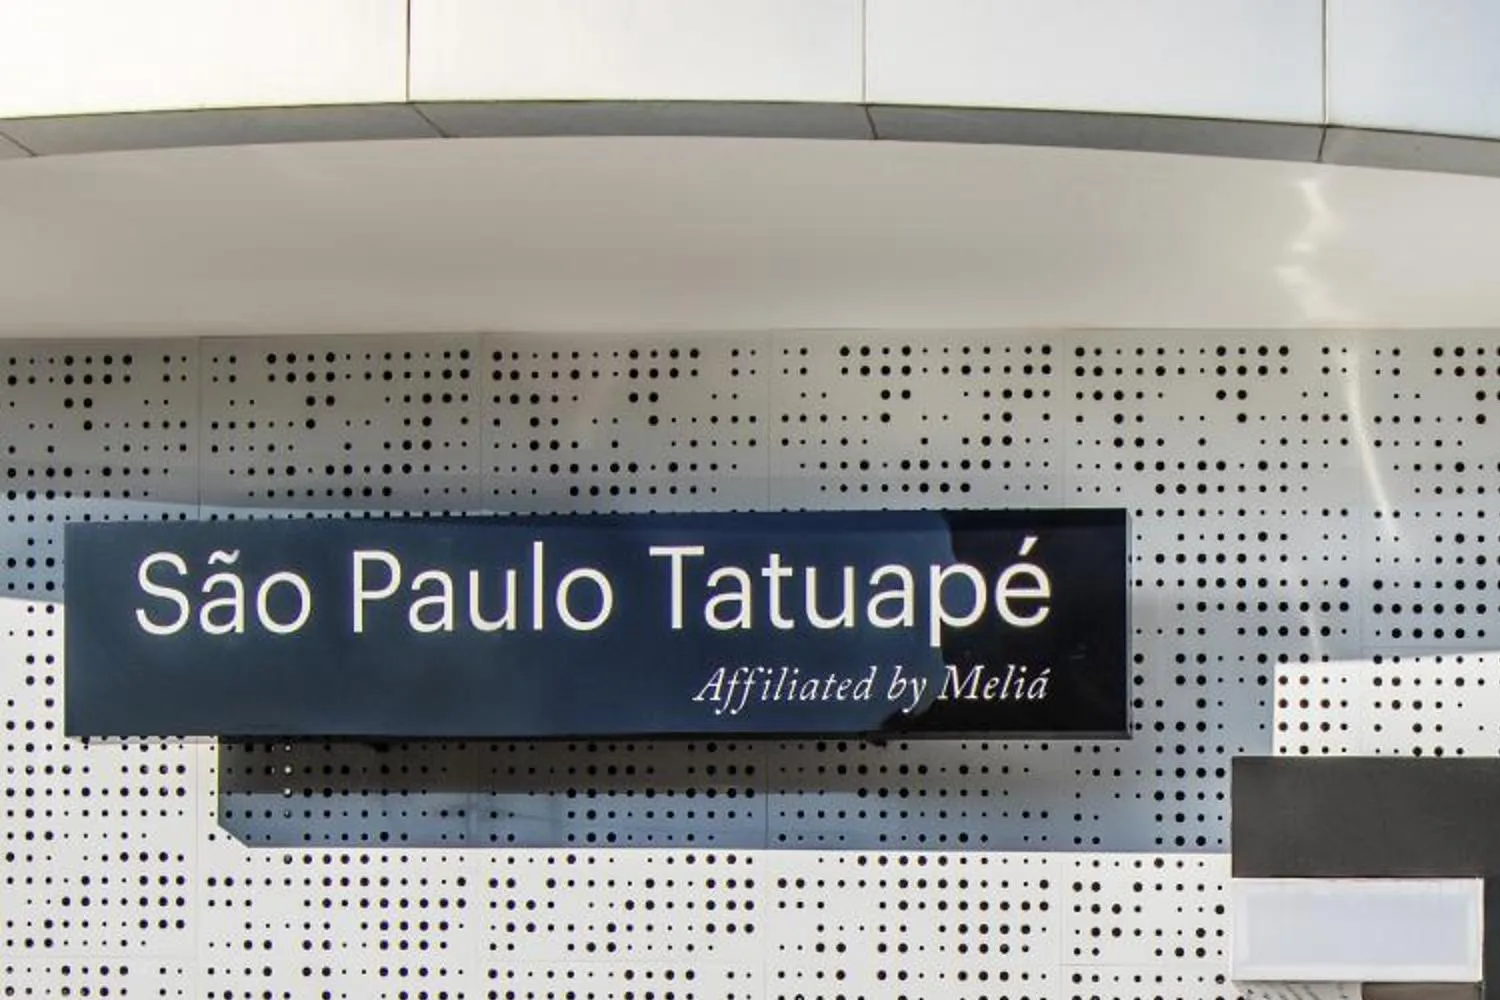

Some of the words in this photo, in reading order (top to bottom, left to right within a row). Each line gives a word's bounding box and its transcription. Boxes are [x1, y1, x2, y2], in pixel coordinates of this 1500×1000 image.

[134, 548, 312, 637] São
[352, 540, 614, 634] Paulo
[647, 536, 1053, 649] Tatuapé
[691, 665, 878, 716] Affiliated
[886, 664, 929, 714] by
[937, 664, 1051, 701] Meliá
